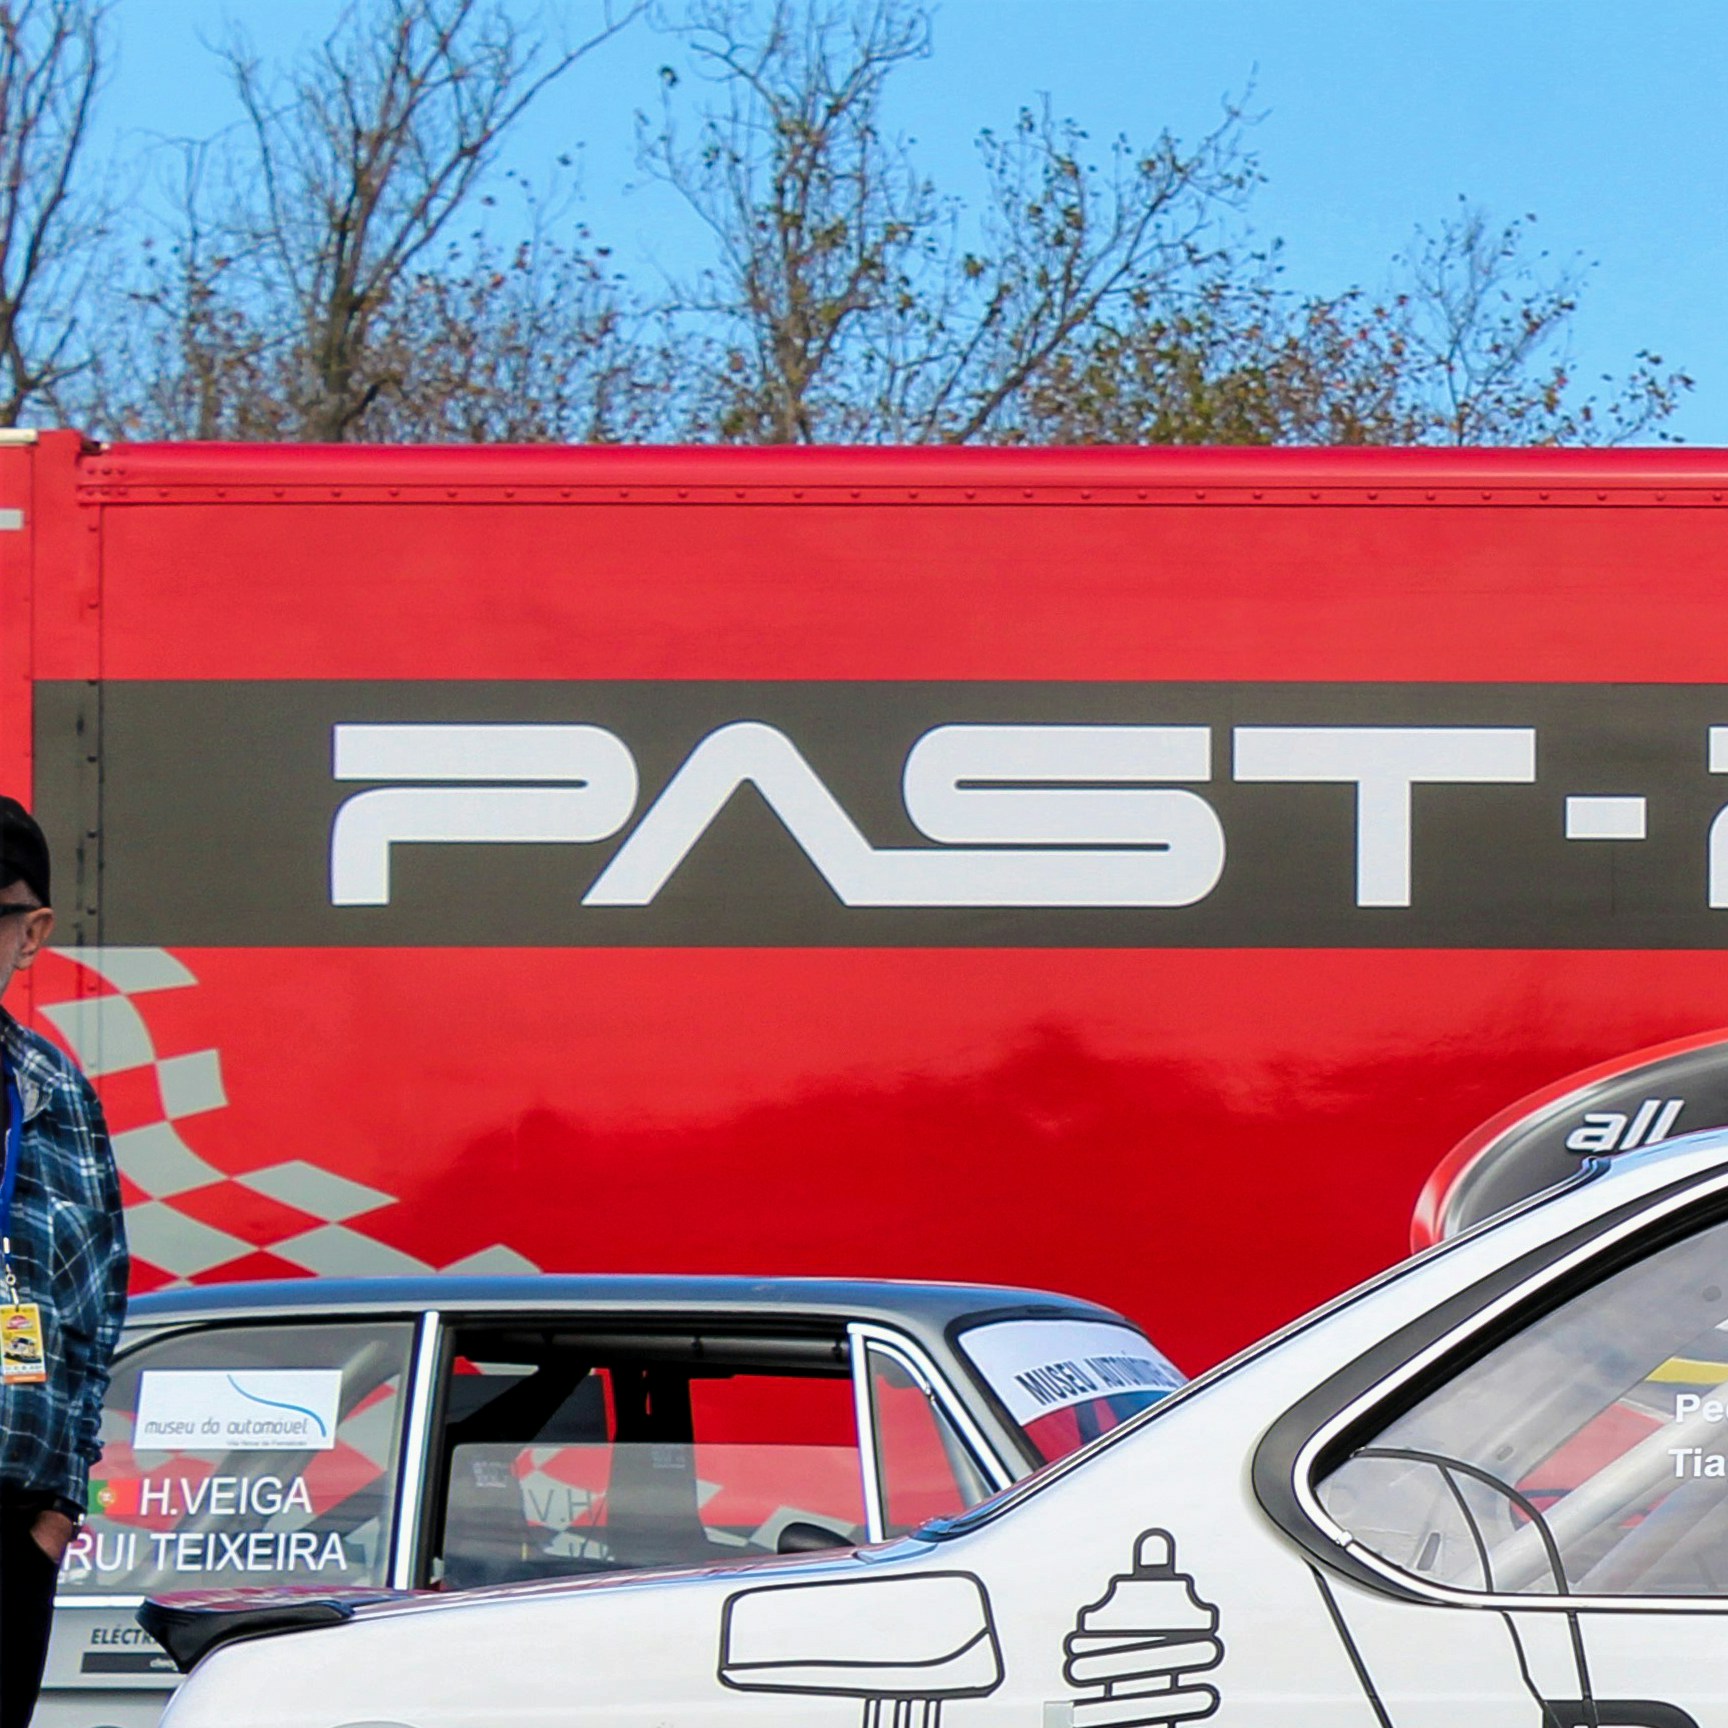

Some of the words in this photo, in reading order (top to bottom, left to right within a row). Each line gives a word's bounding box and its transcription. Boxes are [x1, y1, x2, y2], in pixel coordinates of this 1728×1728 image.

[1567, 1099, 1685, 1152] all
[1014, 1360, 1099, 1406] MUSEU
[144, 1419, 196, 1435] museu
[200, 1417, 221, 1435] do
[139, 1477, 313, 1516] H.VEIGA
[63, 1533, 137, 1571] RUI
[149, 1533, 348, 1571] TEIXEIRA
